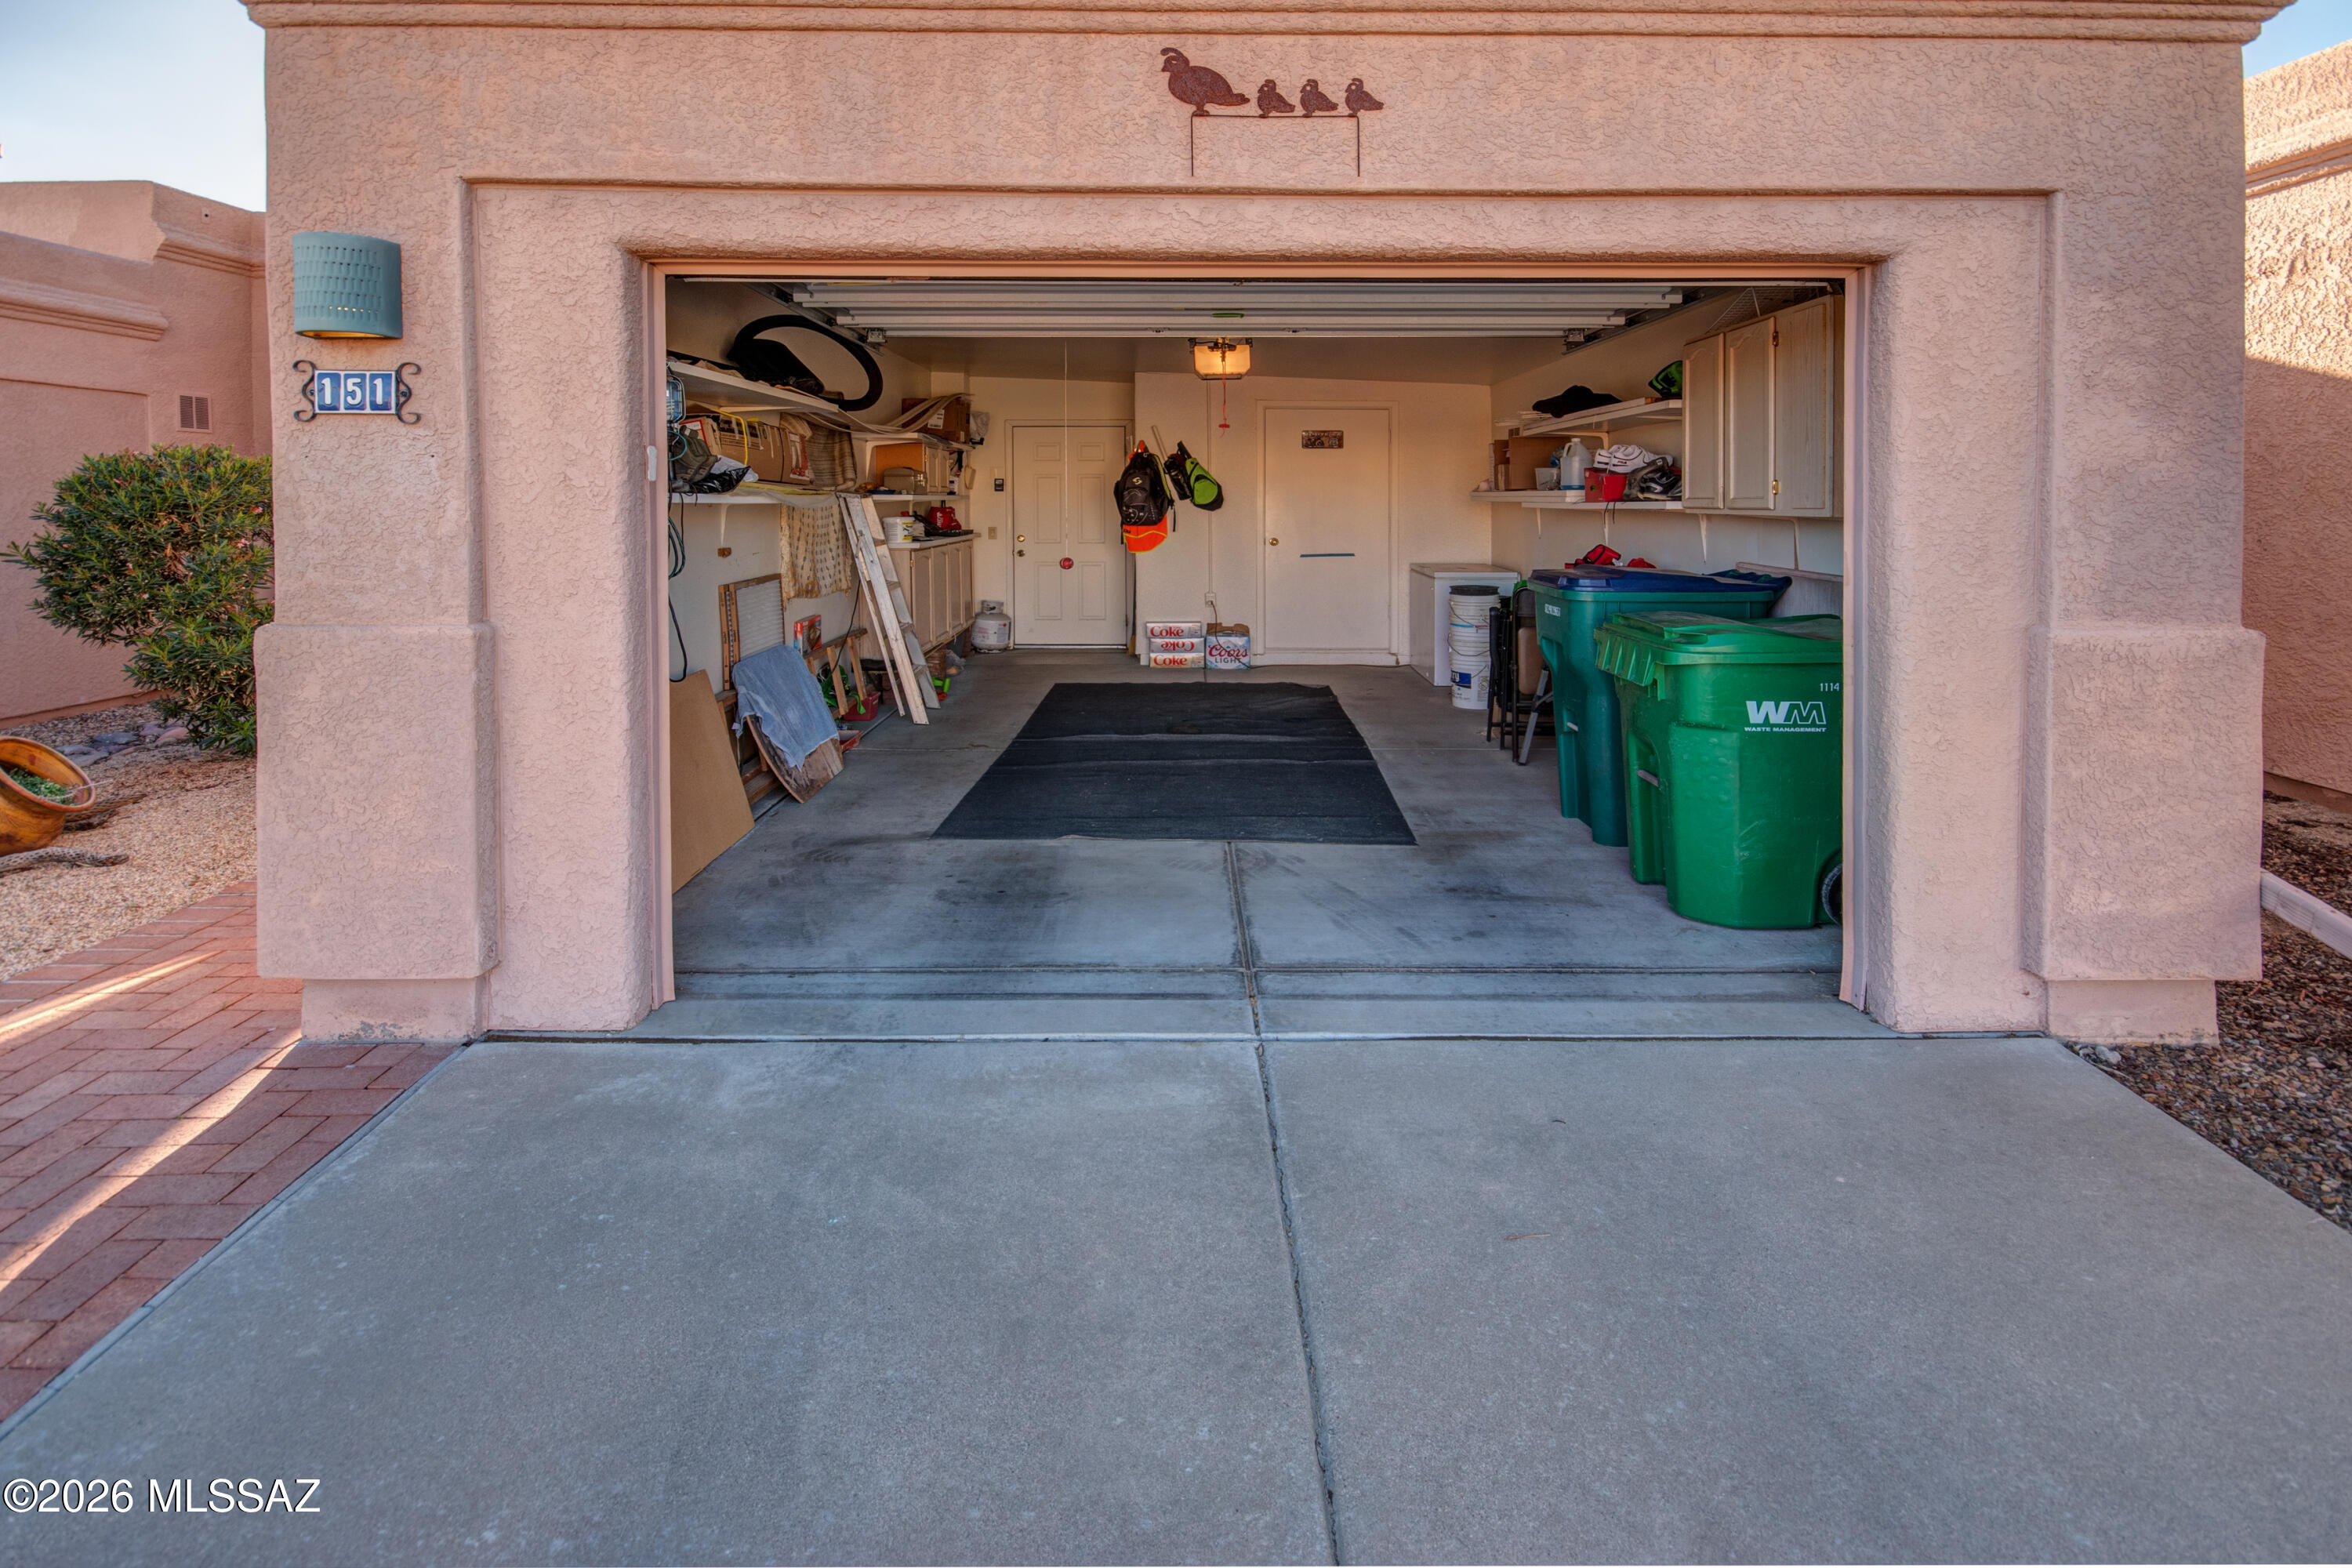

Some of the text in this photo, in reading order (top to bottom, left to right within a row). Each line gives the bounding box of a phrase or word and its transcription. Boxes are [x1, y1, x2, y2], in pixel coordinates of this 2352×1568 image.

[321, 377, 383, 405] 151
[1150, 626, 1184, 637] Coke
[1160, 641, 1194, 652] Coke
[1208, 644, 1248, 657] Coors
[1153, 655, 1187, 666] Coke
[1820, 682, 1840, 691] 1114
[1745, 700, 1827, 725] WM
